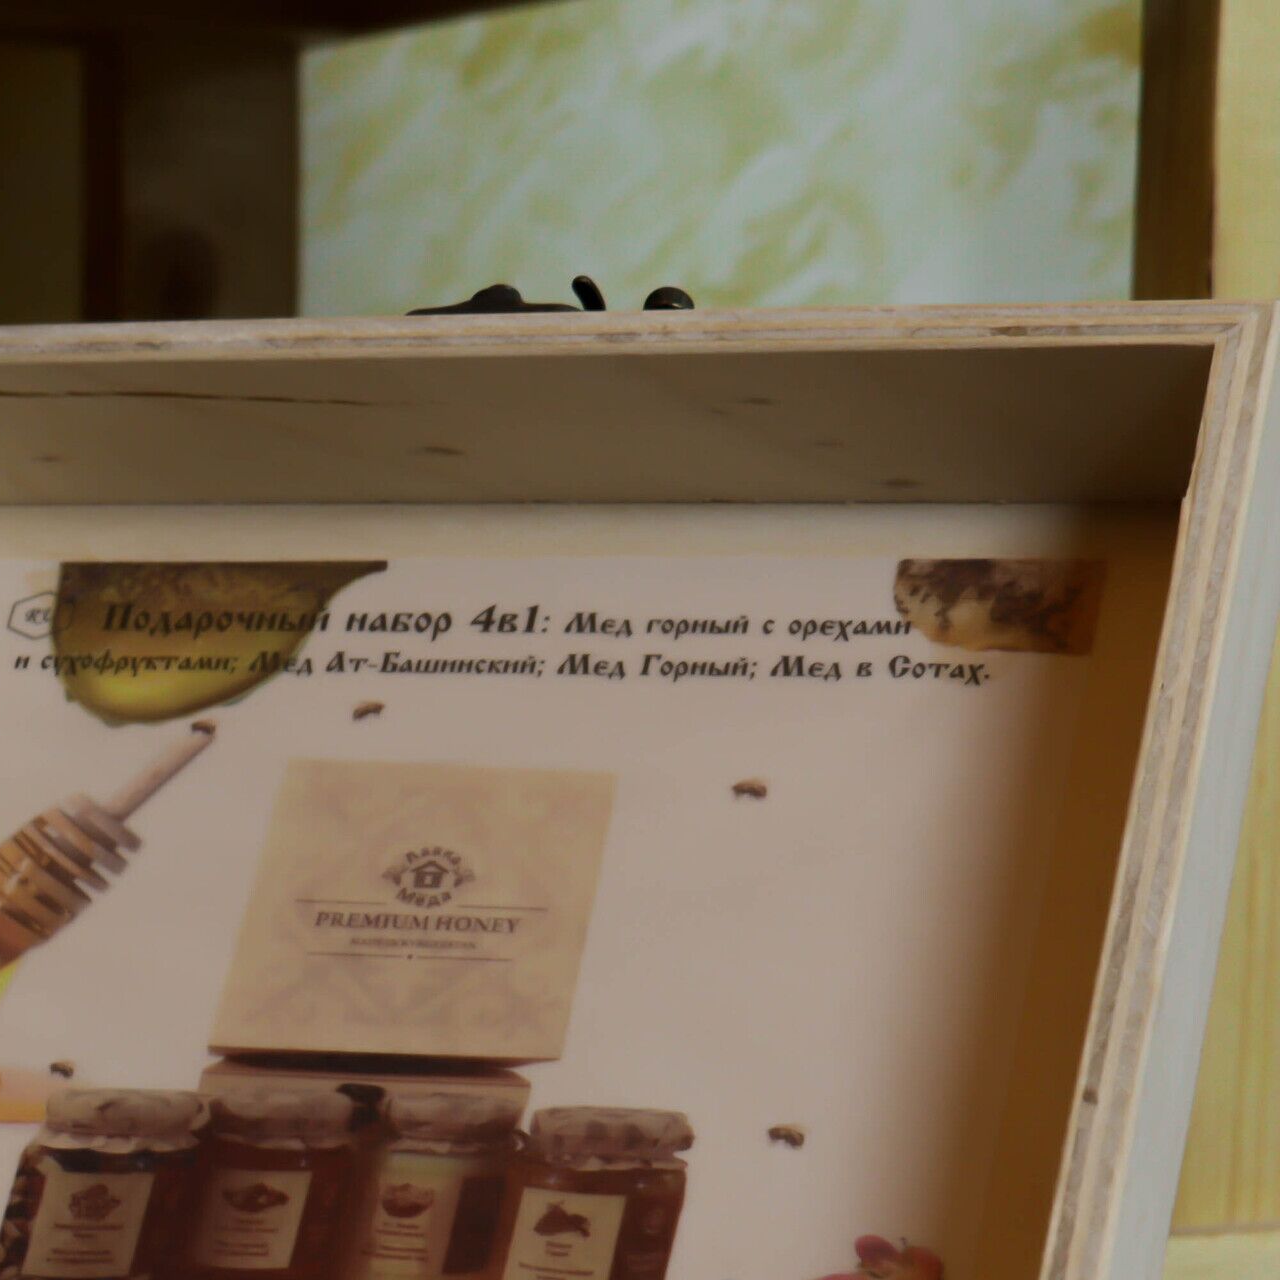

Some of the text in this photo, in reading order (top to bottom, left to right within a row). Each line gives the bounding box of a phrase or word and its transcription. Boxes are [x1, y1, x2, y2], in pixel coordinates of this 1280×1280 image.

[101, 602, 332, 638] Подарочный
[344, 611, 453, 642] набор
[646, 614, 750, 642] горный
[761, 618, 776, 635] с
[788, 617, 913, 643] орехами
[13, 654, 31, 670] и
[325, 650, 547, 677] Ат-Башинский;
[639, 653, 759, 683] Горный;
[855, 661, 874, 679] в
[888, 654, 991, 687] Сотах.
[314, 910, 522, 934] PREMIUM HONEY
